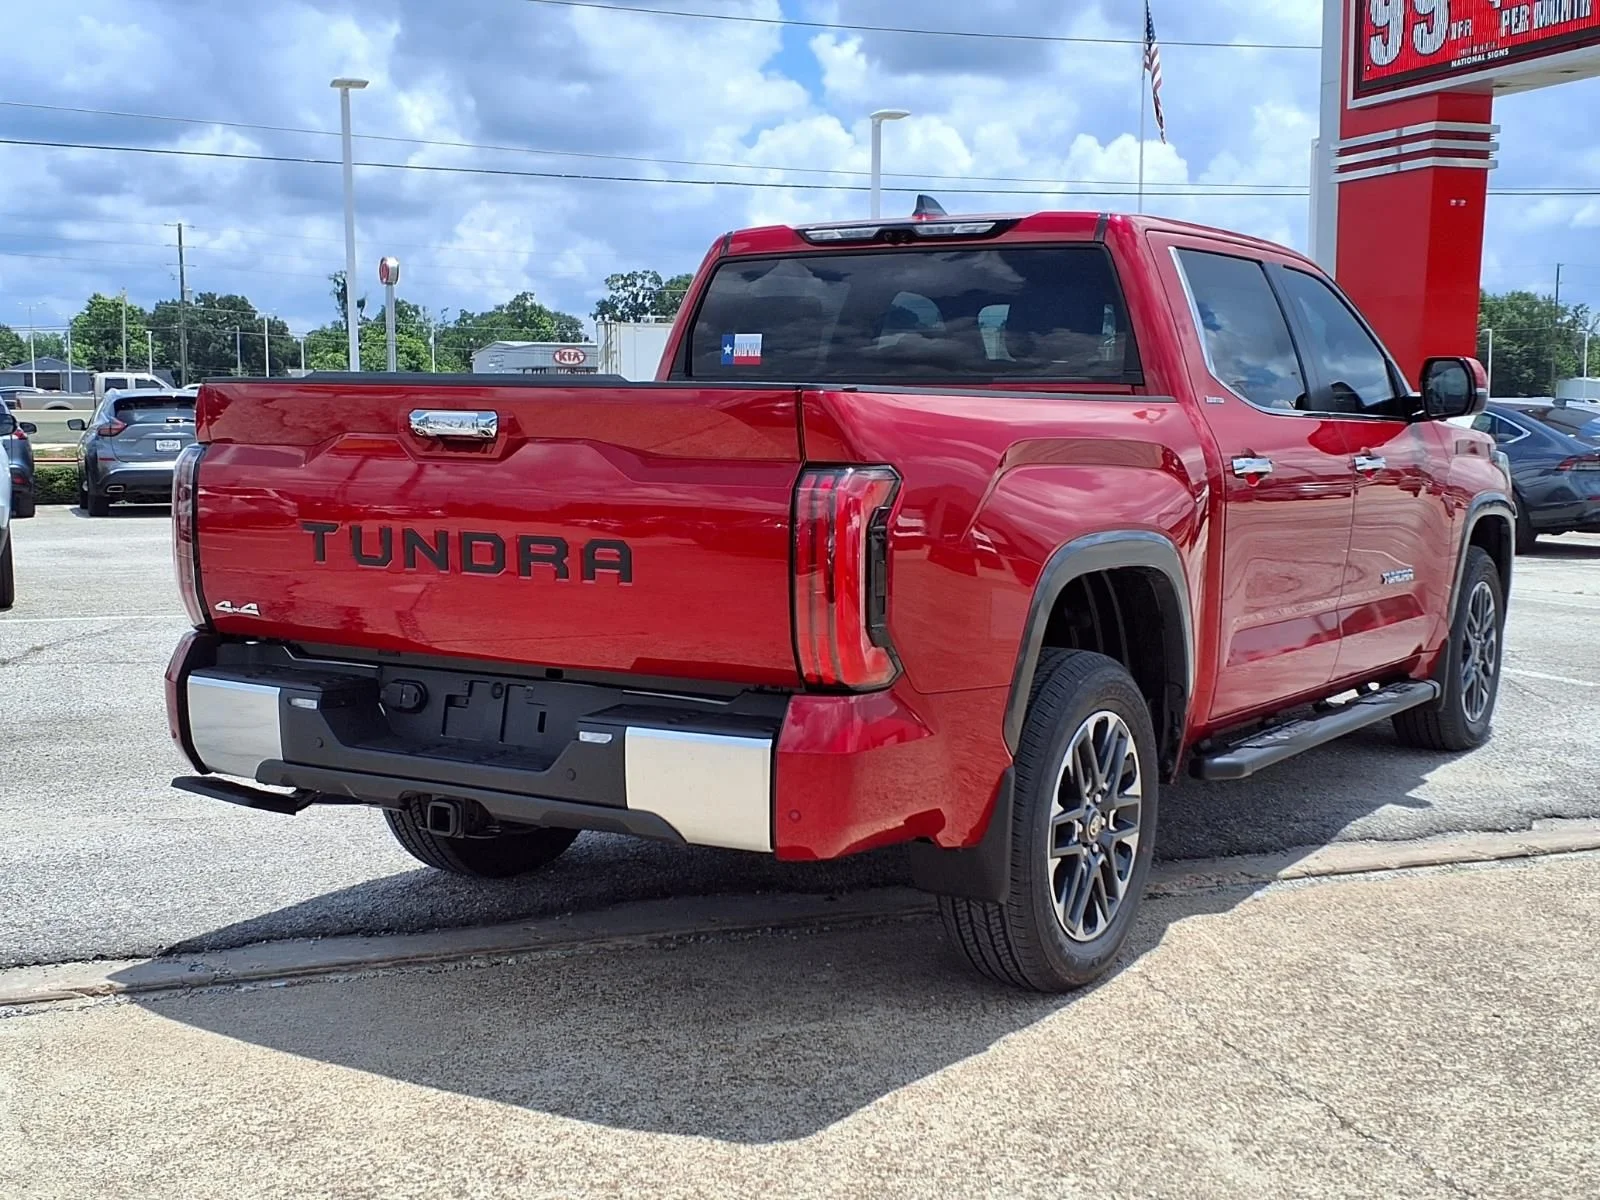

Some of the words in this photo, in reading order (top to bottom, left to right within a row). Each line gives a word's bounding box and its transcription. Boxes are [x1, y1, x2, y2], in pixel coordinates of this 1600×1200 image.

[1500, 4, 1529, 37] PER
[1451, 53, 1485, 67] NATIONAL
[1487, 47, 1509, 60] SIGNS
[558, 351, 581, 362] KIA
[302, 521, 633, 586] TUNDRA
